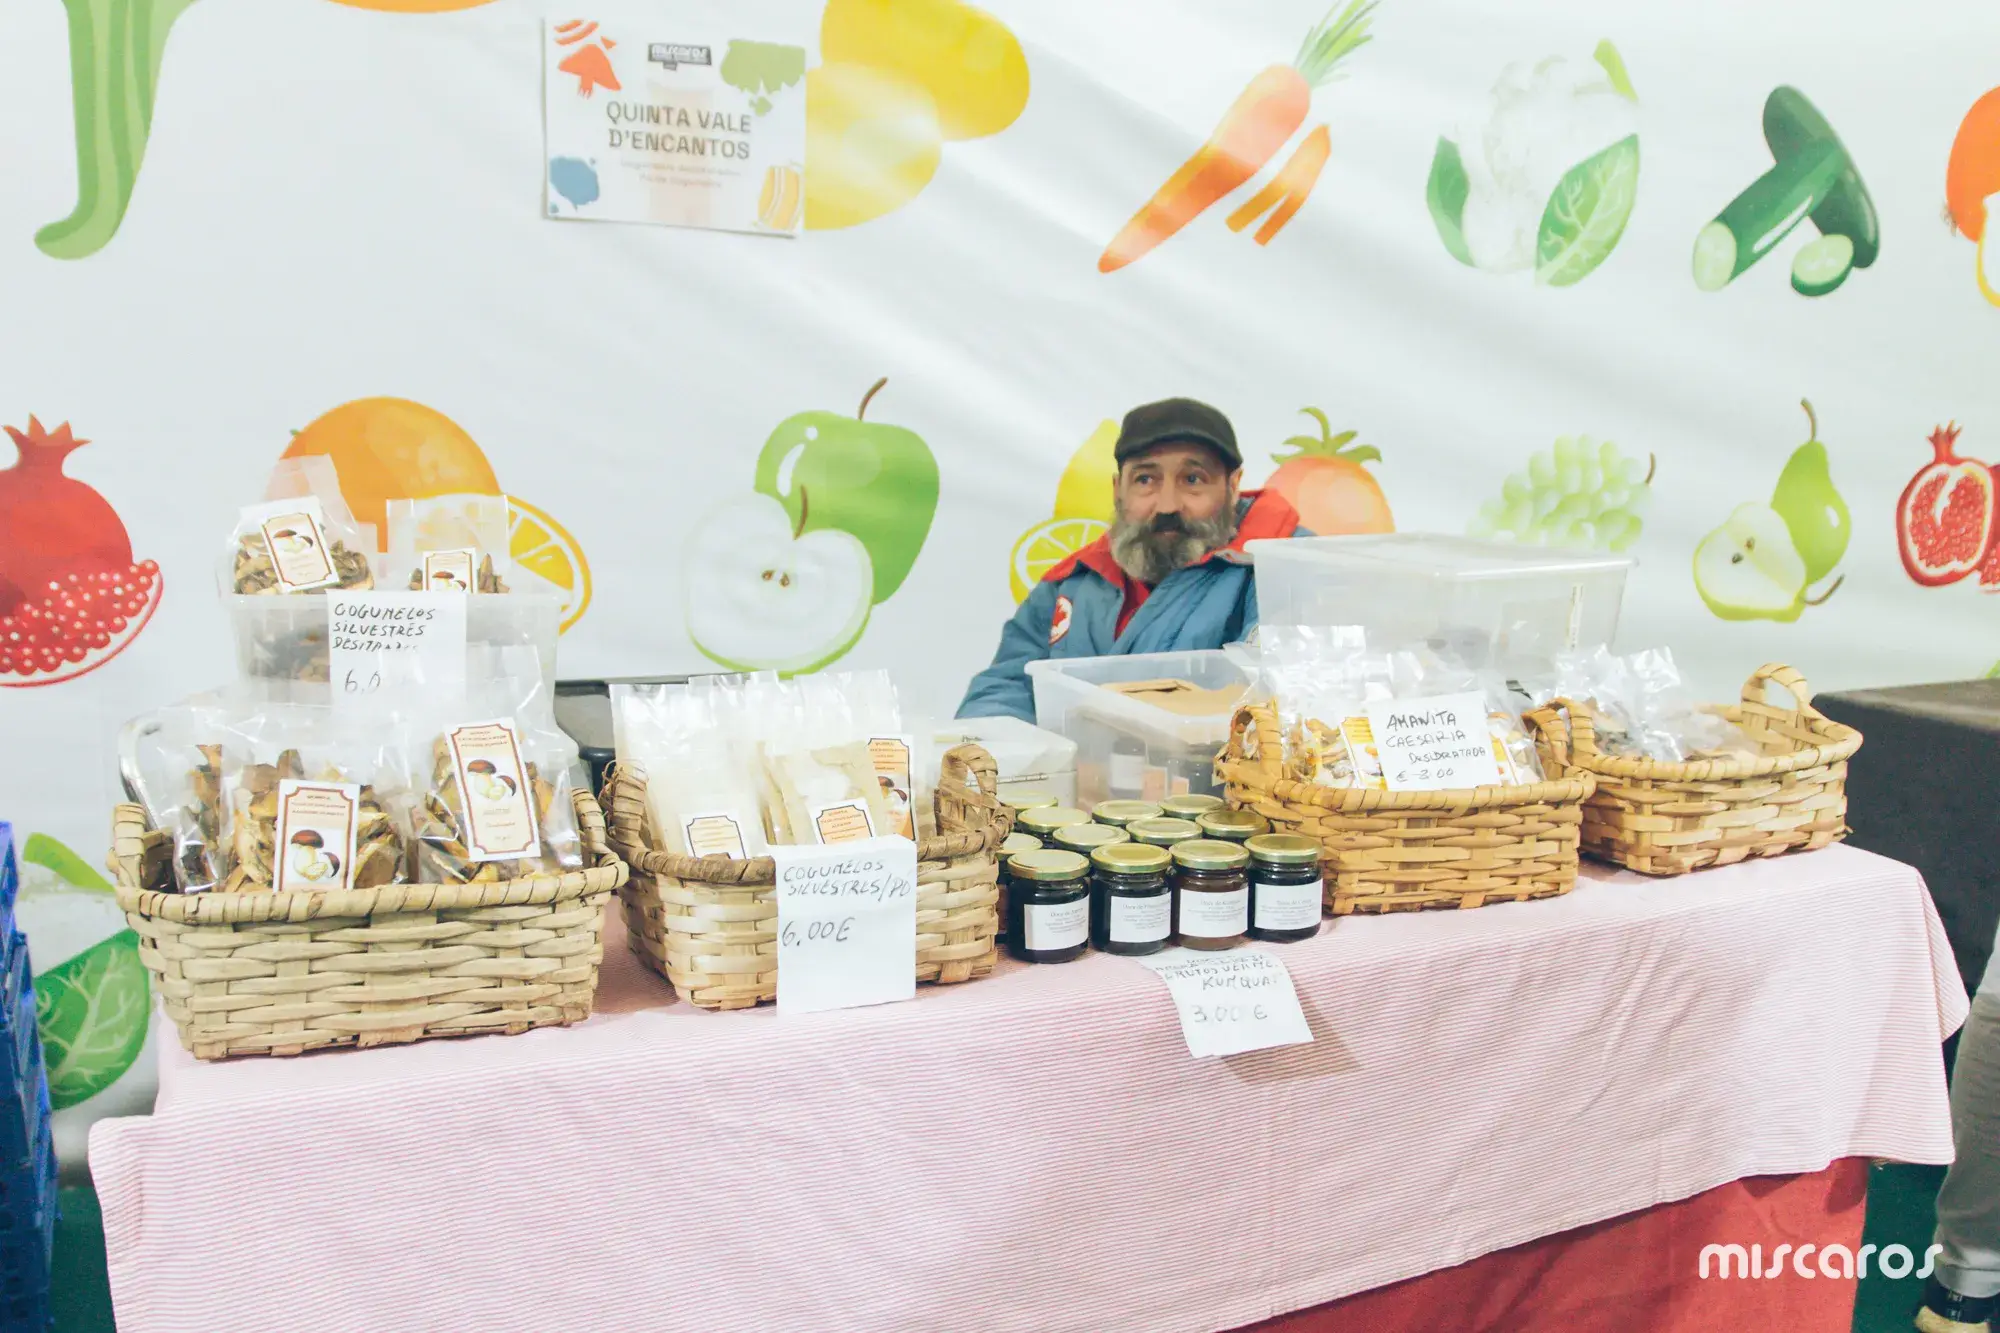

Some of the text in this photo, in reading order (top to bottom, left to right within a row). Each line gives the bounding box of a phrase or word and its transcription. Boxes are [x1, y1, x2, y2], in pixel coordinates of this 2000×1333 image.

[606, 100, 752, 133] QUINTA VALE
[608, 128, 750, 160] D'ENCANTOS
[1386, 709, 1457, 731] AMANITA
[783, 859, 885, 882] COGUMELOS
